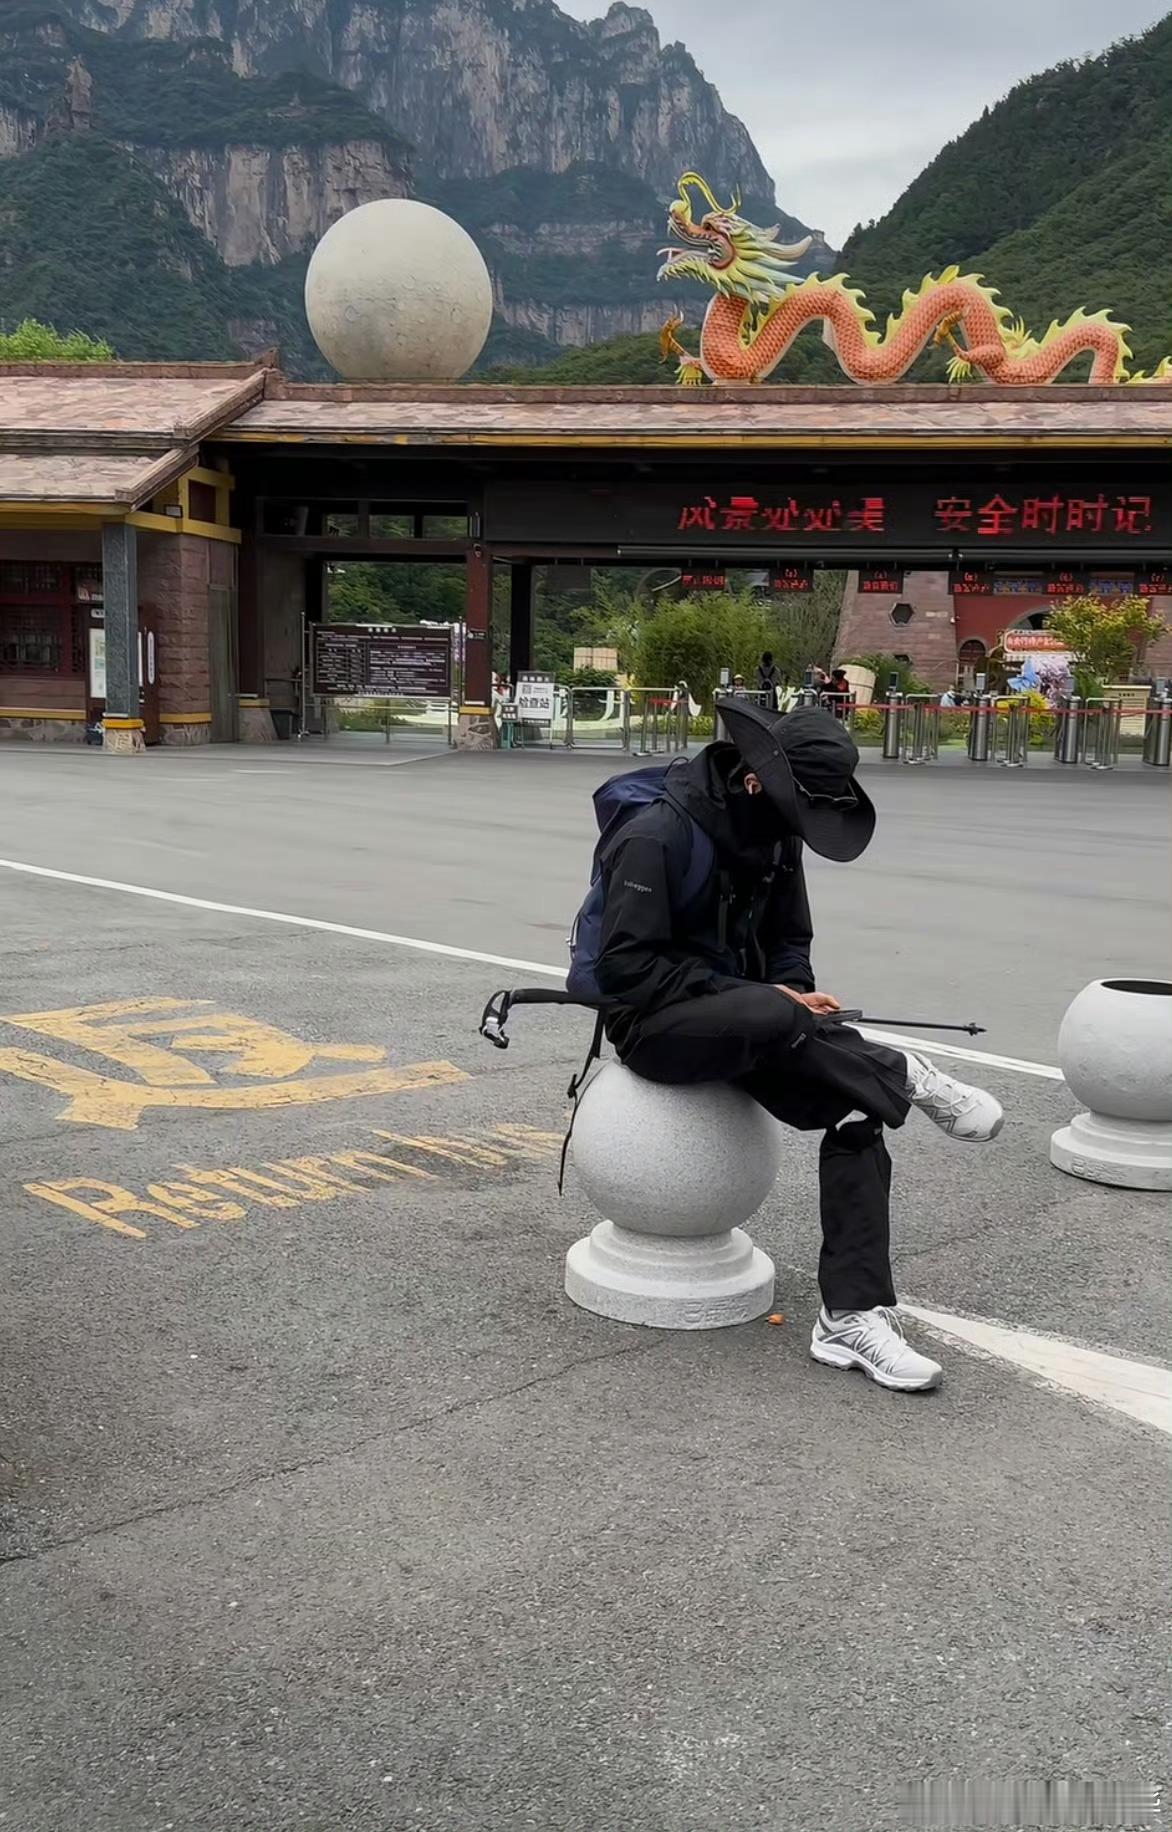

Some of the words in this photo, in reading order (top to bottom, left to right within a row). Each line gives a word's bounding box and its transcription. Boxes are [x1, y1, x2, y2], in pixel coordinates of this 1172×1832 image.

[677, 496, 886, 531] 风景处处美
[934, 494, 1152, 534] 安全时时记
[23, 1150, 438, 1239] Return
